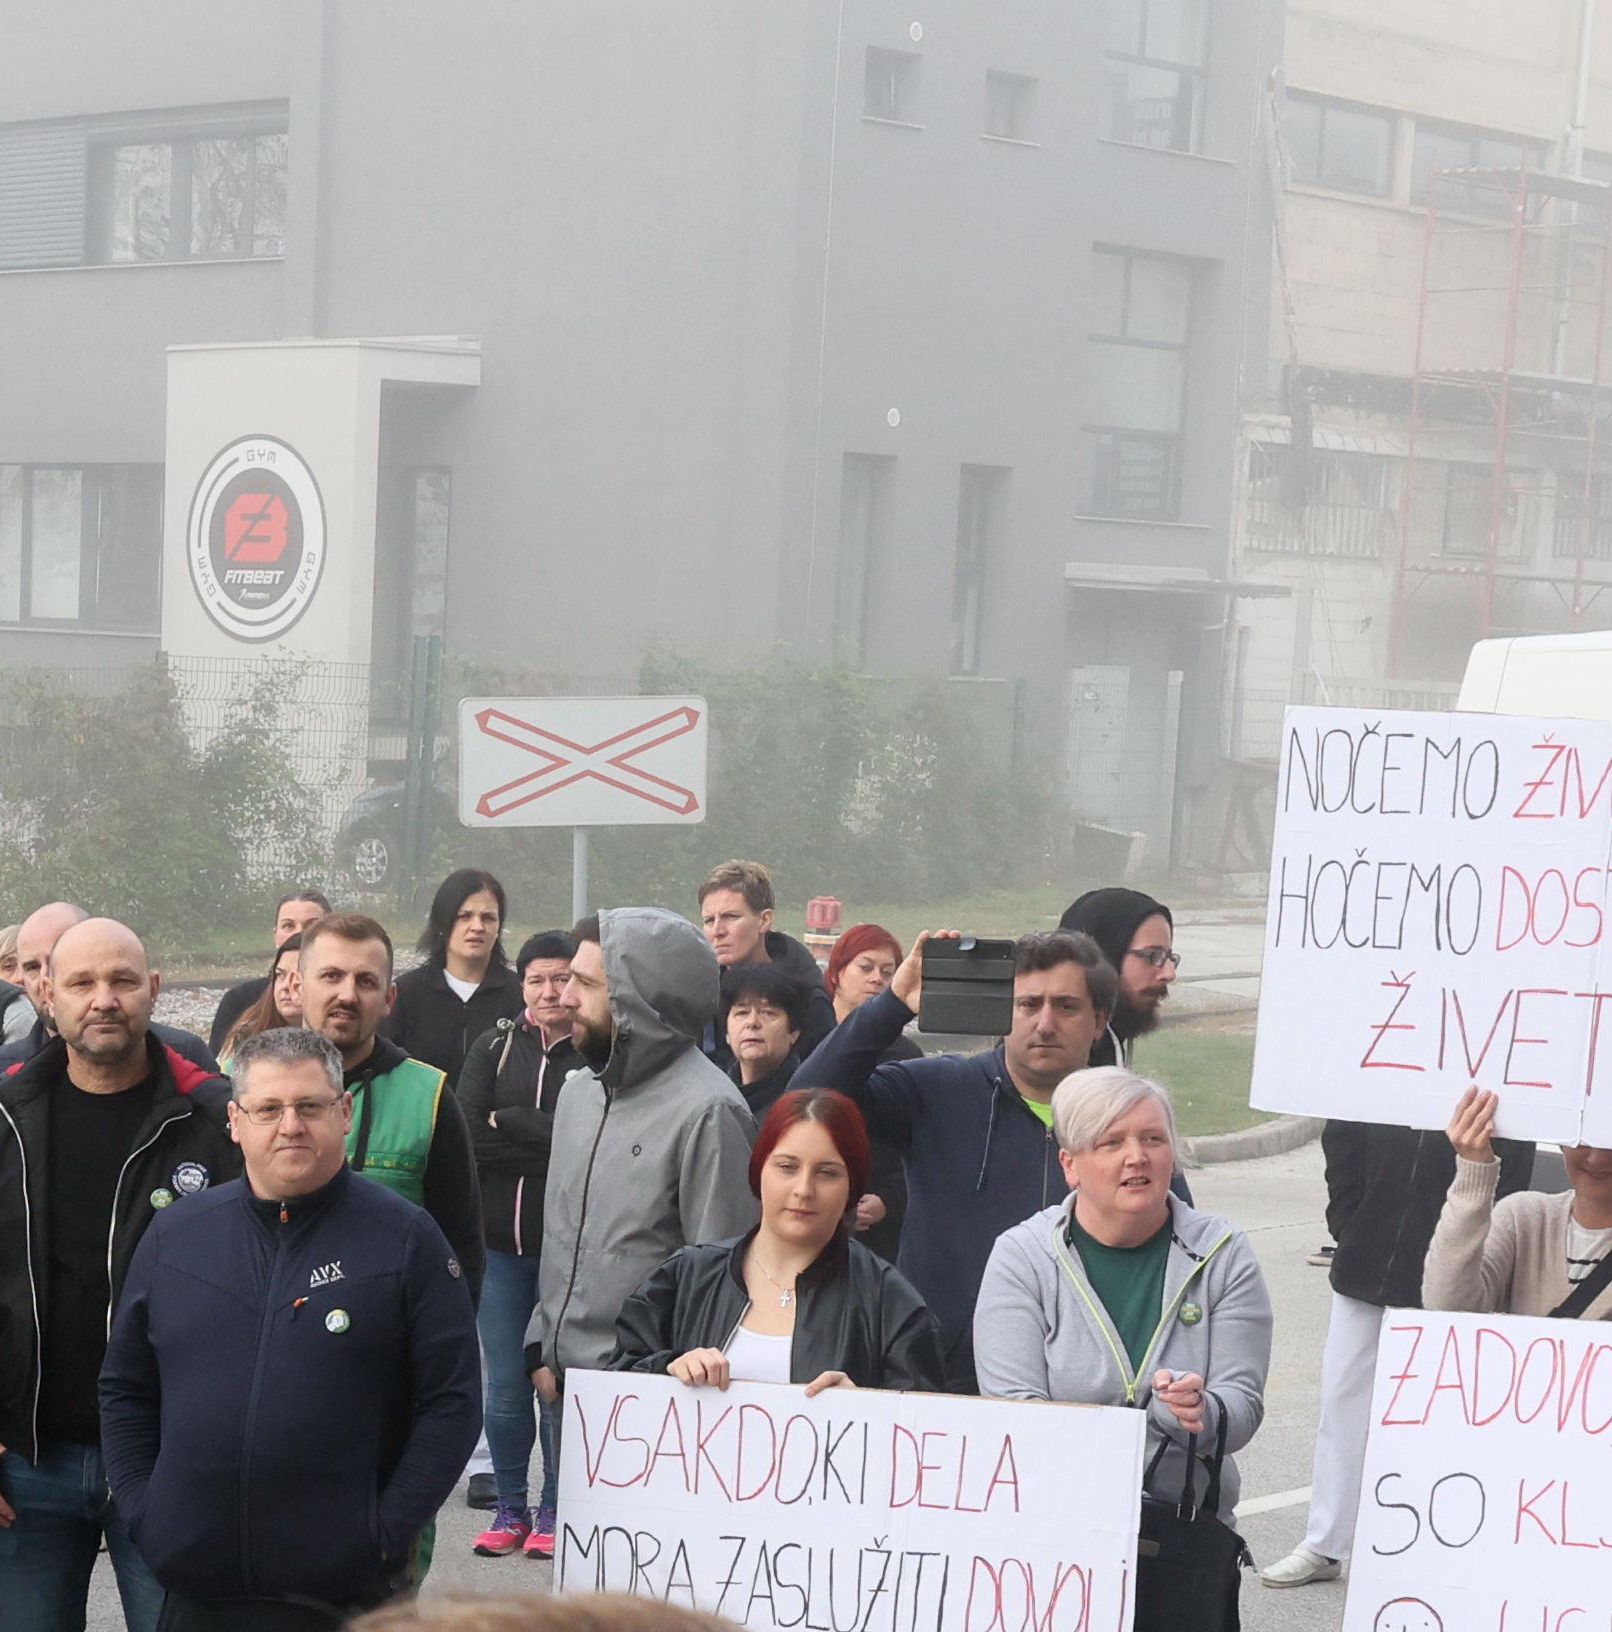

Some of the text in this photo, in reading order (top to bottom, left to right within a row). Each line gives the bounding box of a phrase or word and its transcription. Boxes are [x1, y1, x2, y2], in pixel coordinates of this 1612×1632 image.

[246, 449, 277, 464] GYM
[1285, 721, 1500, 820] NOČEMO
[1275, 848, 1482, 955] HOČEMO
[889, 1424, 1021, 1513] DELA
[1371, 1472, 1486, 1556] SO
